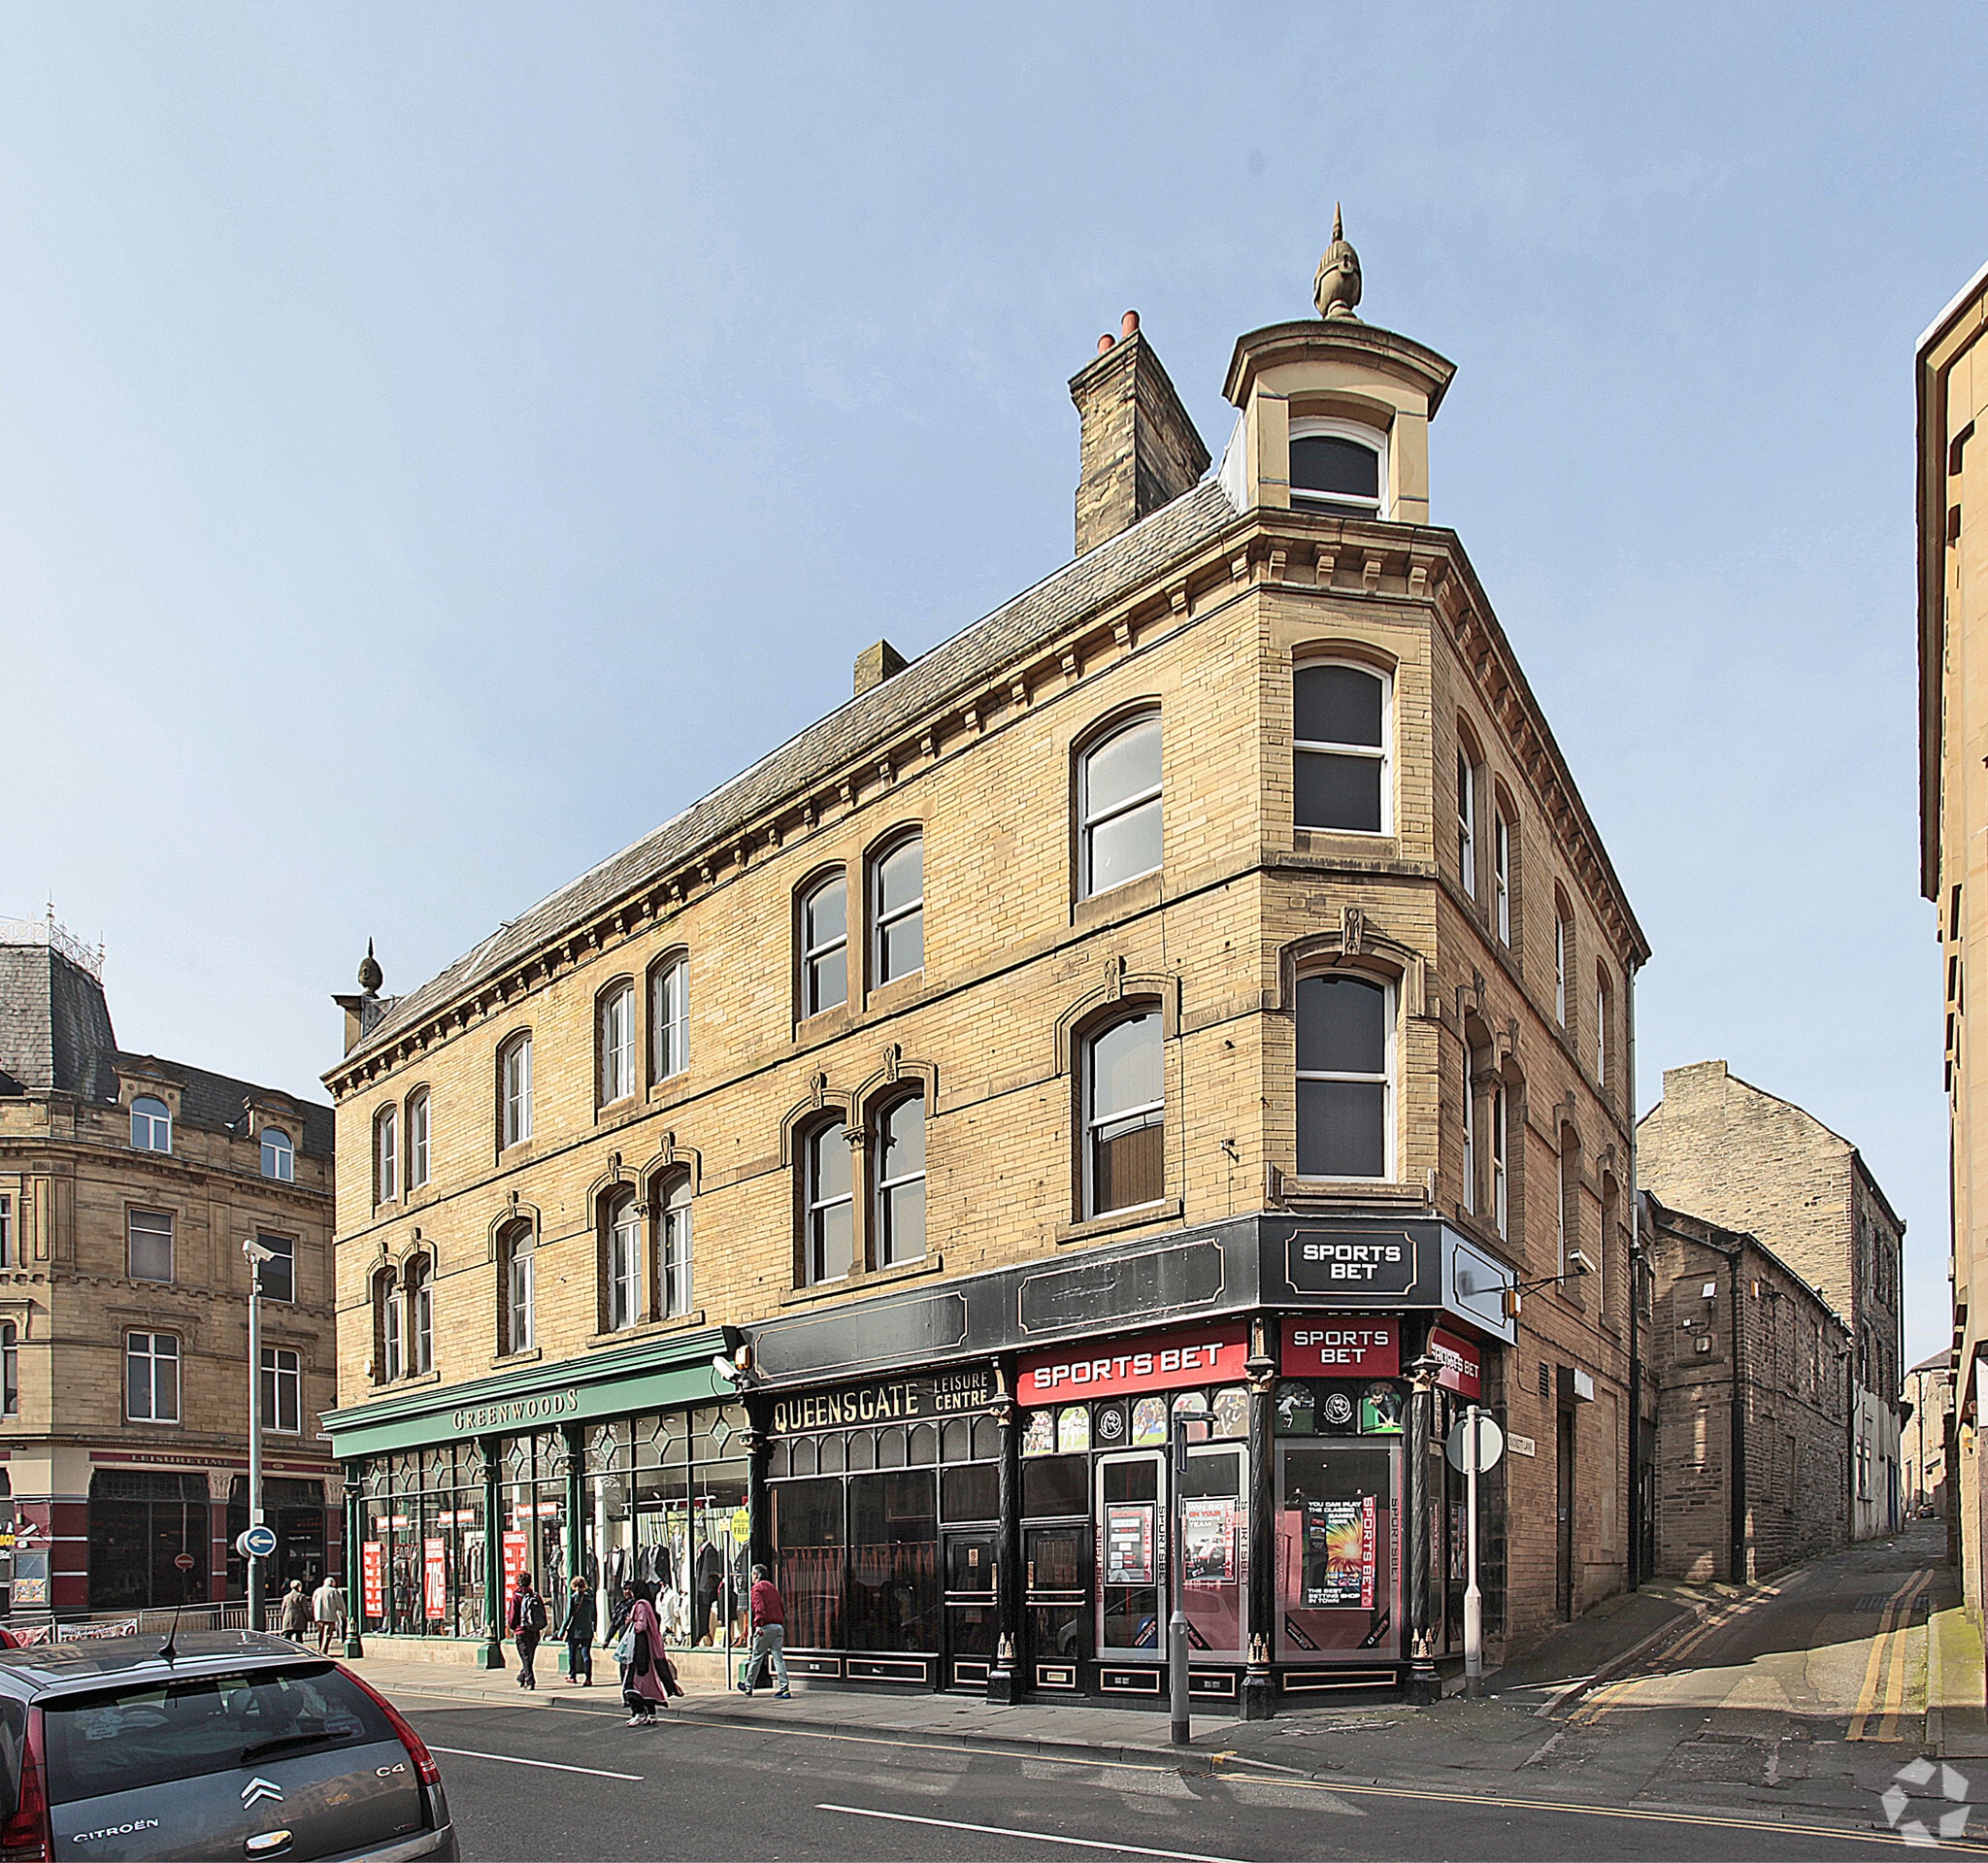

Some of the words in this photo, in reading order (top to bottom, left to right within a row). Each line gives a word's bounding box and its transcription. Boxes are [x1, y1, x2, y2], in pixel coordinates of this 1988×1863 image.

[1303, 1244, 1402, 1262] SPORTS
[1330, 1263, 1378, 1280] BET
[1293, 1330, 1389, 1346] SPORTS
[1033, 1352, 1153, 1388] SPORTS
[1160, 1342, 1224, 1372] BET
[1320, 1348, 1367, 1364] BET
[1465, 1360, 1479, 1379] BET
[933, 1371, 988, 1394] LEISURE
[451, 1388, 580, 1431] GREENWOODS
[775, 1382, 919, 1434] QUEENSGATE
[935, 1388, 988, 1412] CENTRE
[131, 1454, 233, 1466] LEISURETIME
[1363, 1496, 1374, 1562] SPORTS
[1362, 1564, 1373, 1596] BET
[375, 1762, 407, 1779] C4
[72, 1818, 160, 1844] CITROËN
